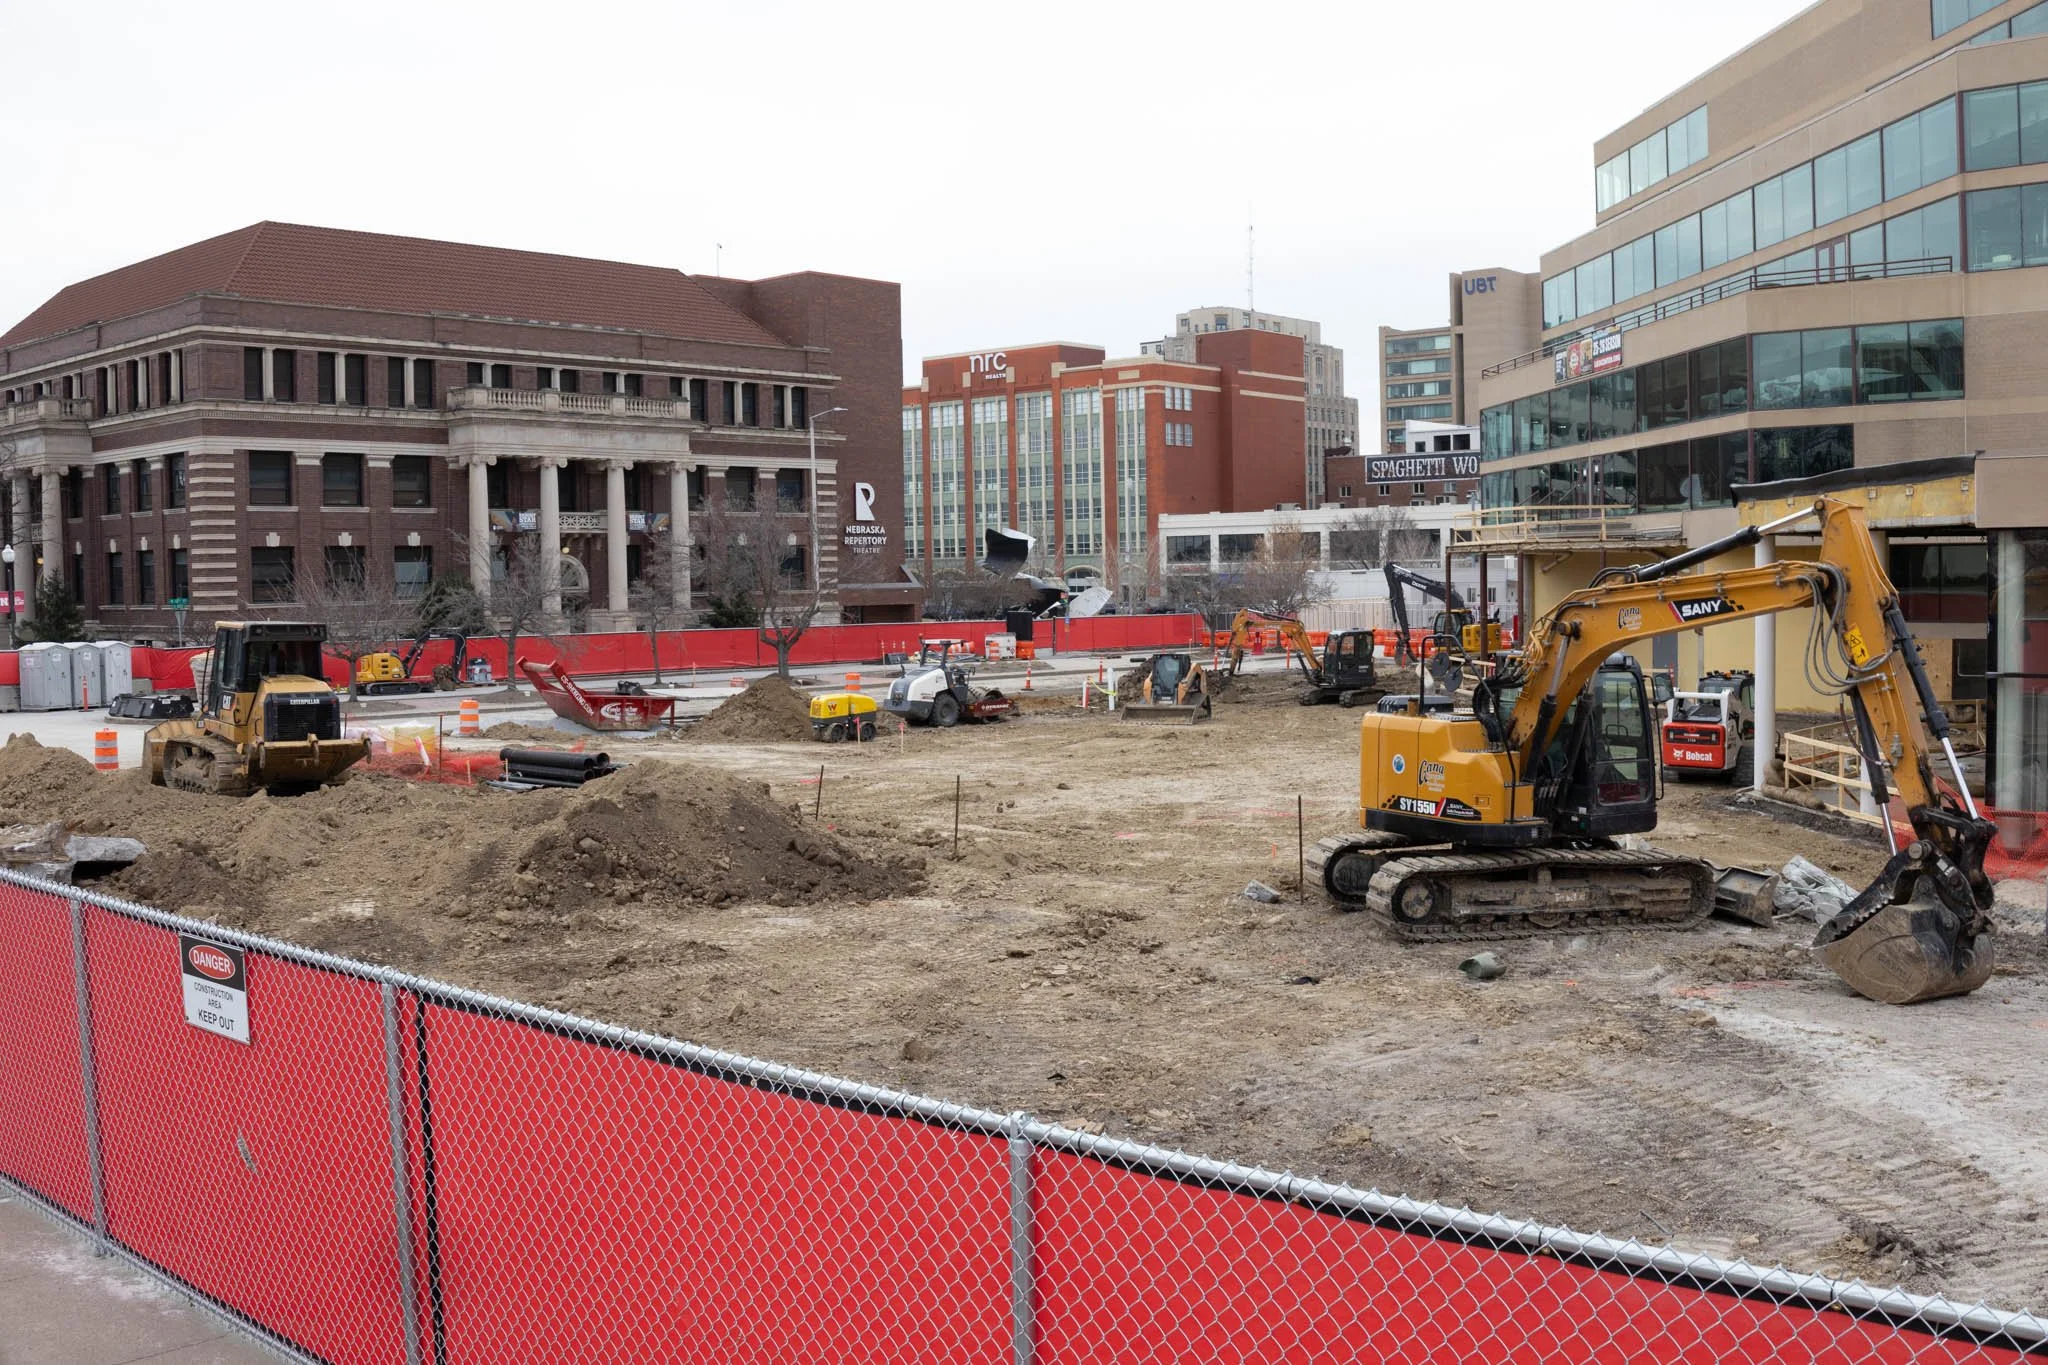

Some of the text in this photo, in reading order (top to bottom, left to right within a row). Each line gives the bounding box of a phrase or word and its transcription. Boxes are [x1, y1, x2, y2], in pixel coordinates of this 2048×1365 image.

[1464, 275, 1497, 296] UBT
[969, 352, 1007, 373] nrc
[1371, 456, 1480, 479] SPAGHETTI WO
[845, 525, 886, 534] NEBRASKA
[844, 536, 888, 545] REPERTORY
[1681, 599, 1722, 617] SANY
[222, 695, 232, 710] CAT
[1685, 750, 1713, 762] Bobcat
[1399, 797, 1436, 815] SY155U
[193, 949, 232, 975] DANGER
[193, 981, 234, 1003] CONSTRUCTION
[207, 998, 222, 1009] AREA
[197, 1007, 235, 1032] KEEP OUT
